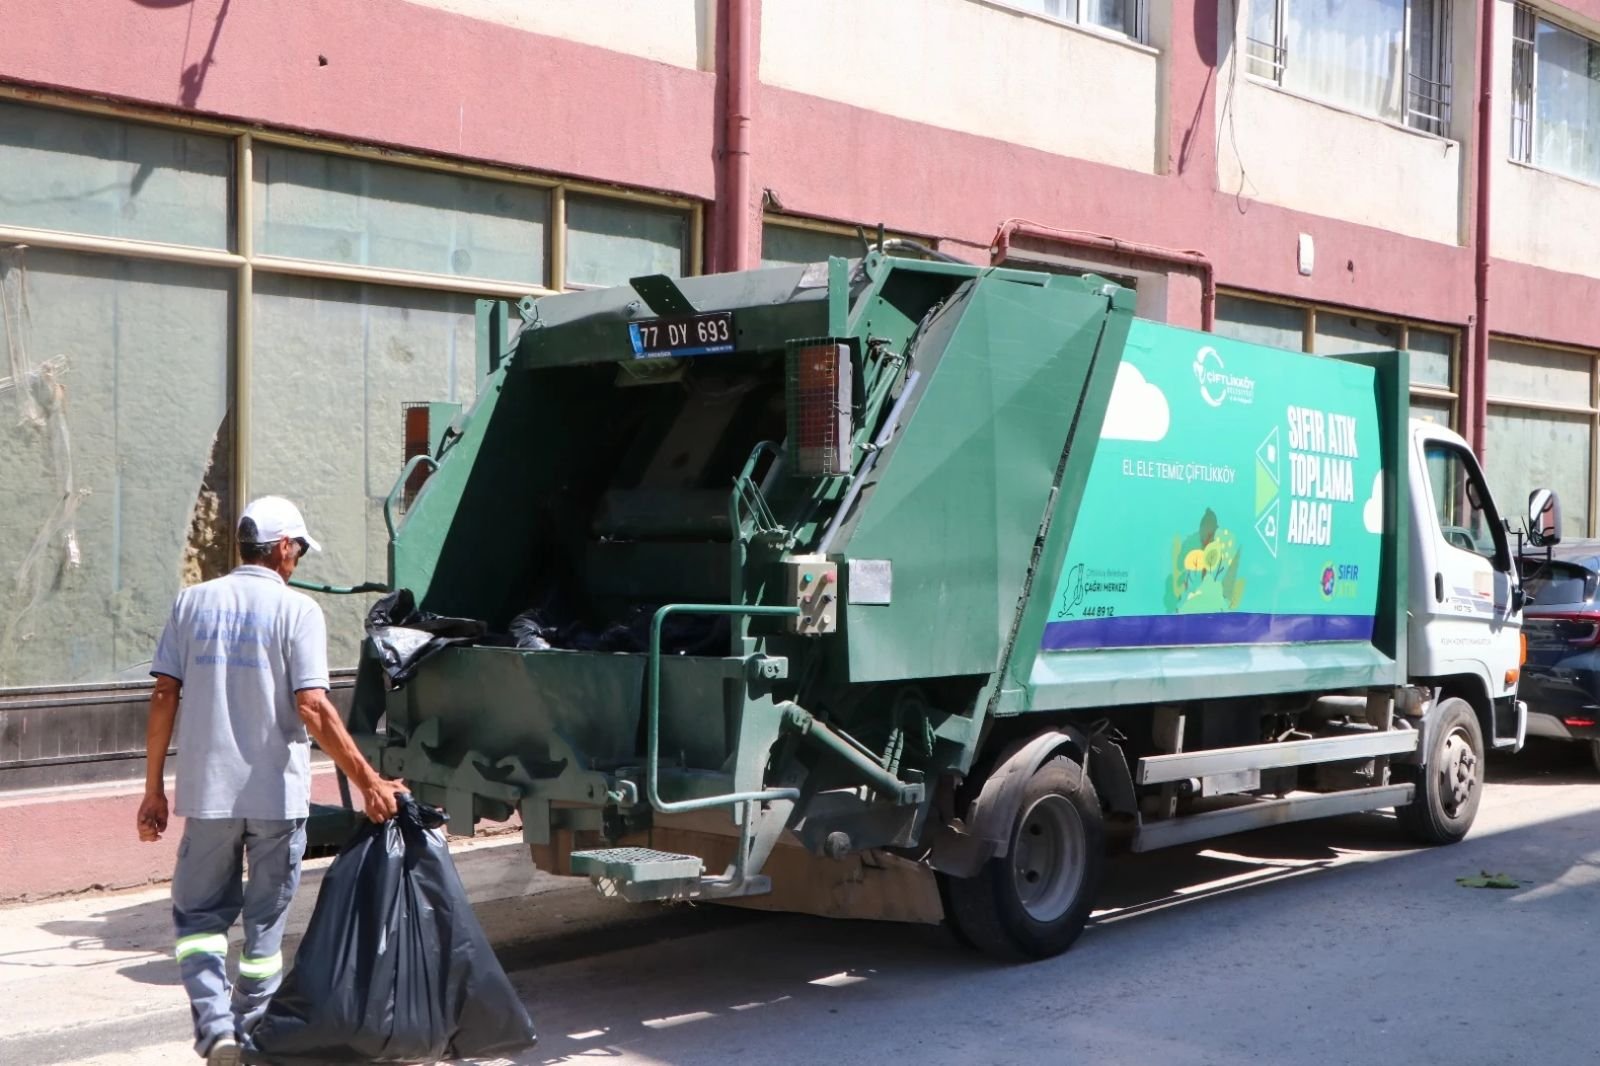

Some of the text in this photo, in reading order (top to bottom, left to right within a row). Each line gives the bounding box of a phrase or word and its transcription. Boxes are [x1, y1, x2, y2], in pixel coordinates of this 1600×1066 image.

[640, 319, 729, 348] 77 DY 693
[1287, 405, 1359, 459] SIFIR ATIK
[1122, 459, 1236, 484] EL ELE TEMİZ ÇİFTLİKKÖY
[1288, 452, 1355, 504] TOPLAMA
[1287, 500, 1333, 546] ARACI
[1338, 564, 1359, 581] SIFIR
[1084, 580, 1128, 595] ÇAĞRI MERKEZİ
[1082, 606, 1096, 617] 444
